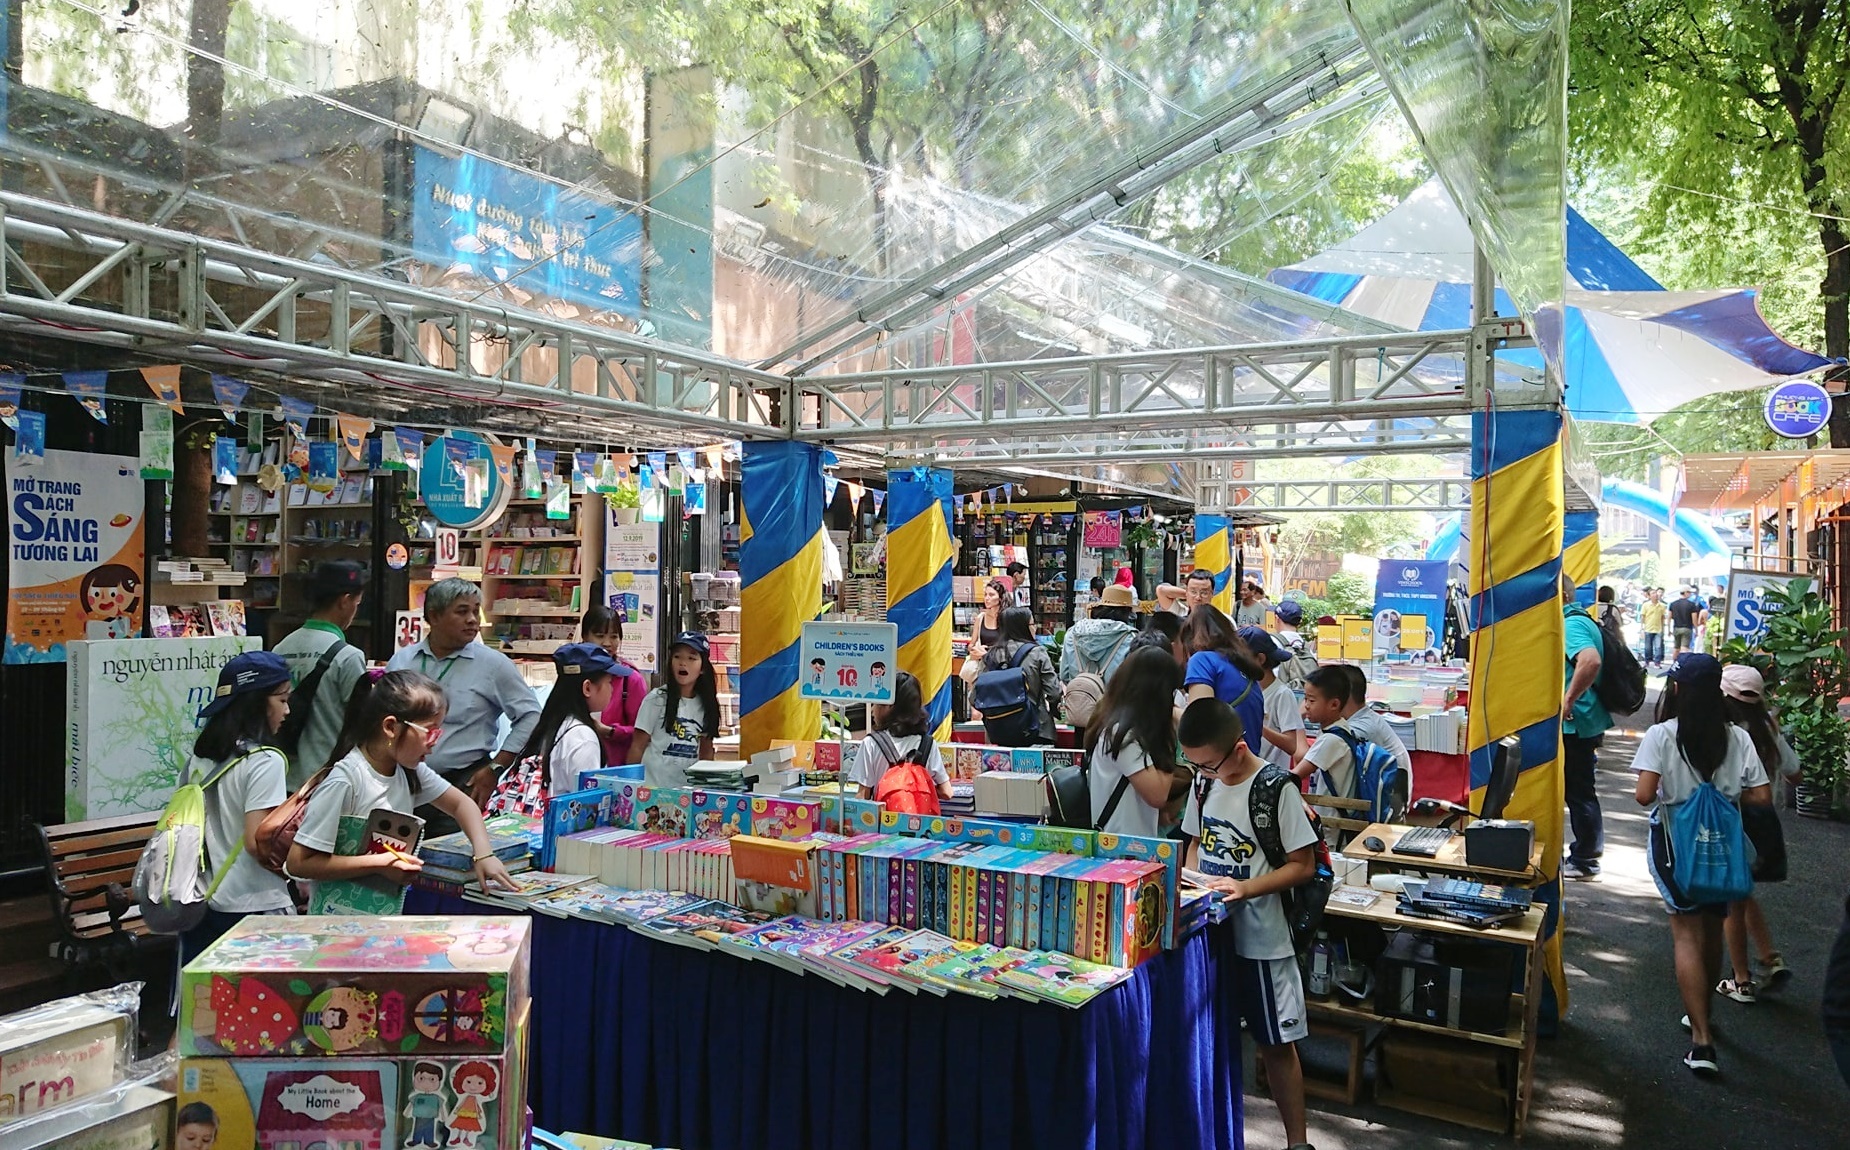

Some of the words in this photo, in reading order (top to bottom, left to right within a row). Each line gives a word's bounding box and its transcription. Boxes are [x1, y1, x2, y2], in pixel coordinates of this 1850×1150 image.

[13, 475, 35, 493] MỞ
[37, 480, 81, 495] TRANG
[1086, 525, 1119, 542] 24h
[13, 543, 68, 561] TƯƠNG
[73, 546, 98, 562] LAI
[438, 532, 456, 559] 10
[398, 616, 421, 648] 35
[814, 641, 858, 650] CHILDREN'S
[858, 643, 885, 651] BOOKS
[103, 652, 174, 683] nguyễn
[177, 647, 217, 672] nhật
[836, 668, 858, 686] 10%
[288, 1088, 297, 1096] My
[306, 1095, 341, 1109] Home
